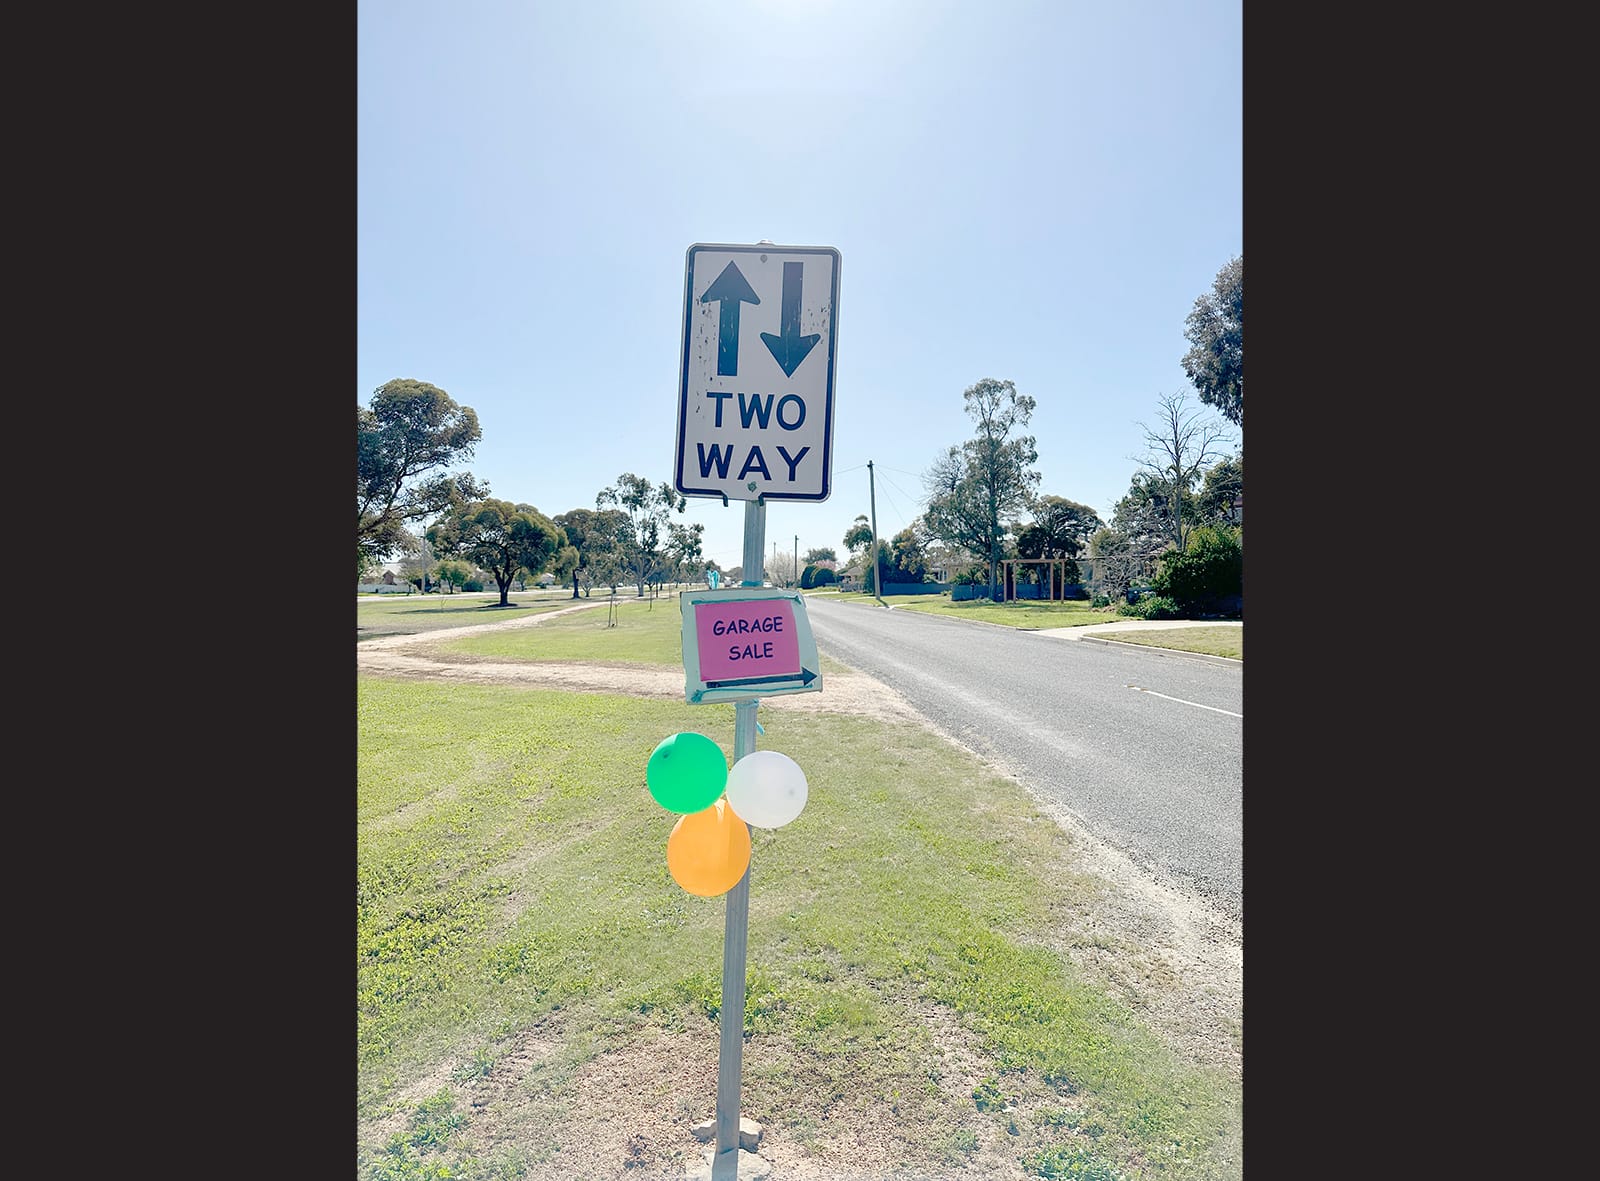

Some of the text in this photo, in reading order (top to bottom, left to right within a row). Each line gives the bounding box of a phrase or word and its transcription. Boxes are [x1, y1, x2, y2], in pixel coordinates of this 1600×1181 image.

[706, 391, 806, 431] TWO
[697, 443, 811, 482] WAY
[713, 616, 783, 636] GARAGE
[729, 642, 774, 661] SALE
